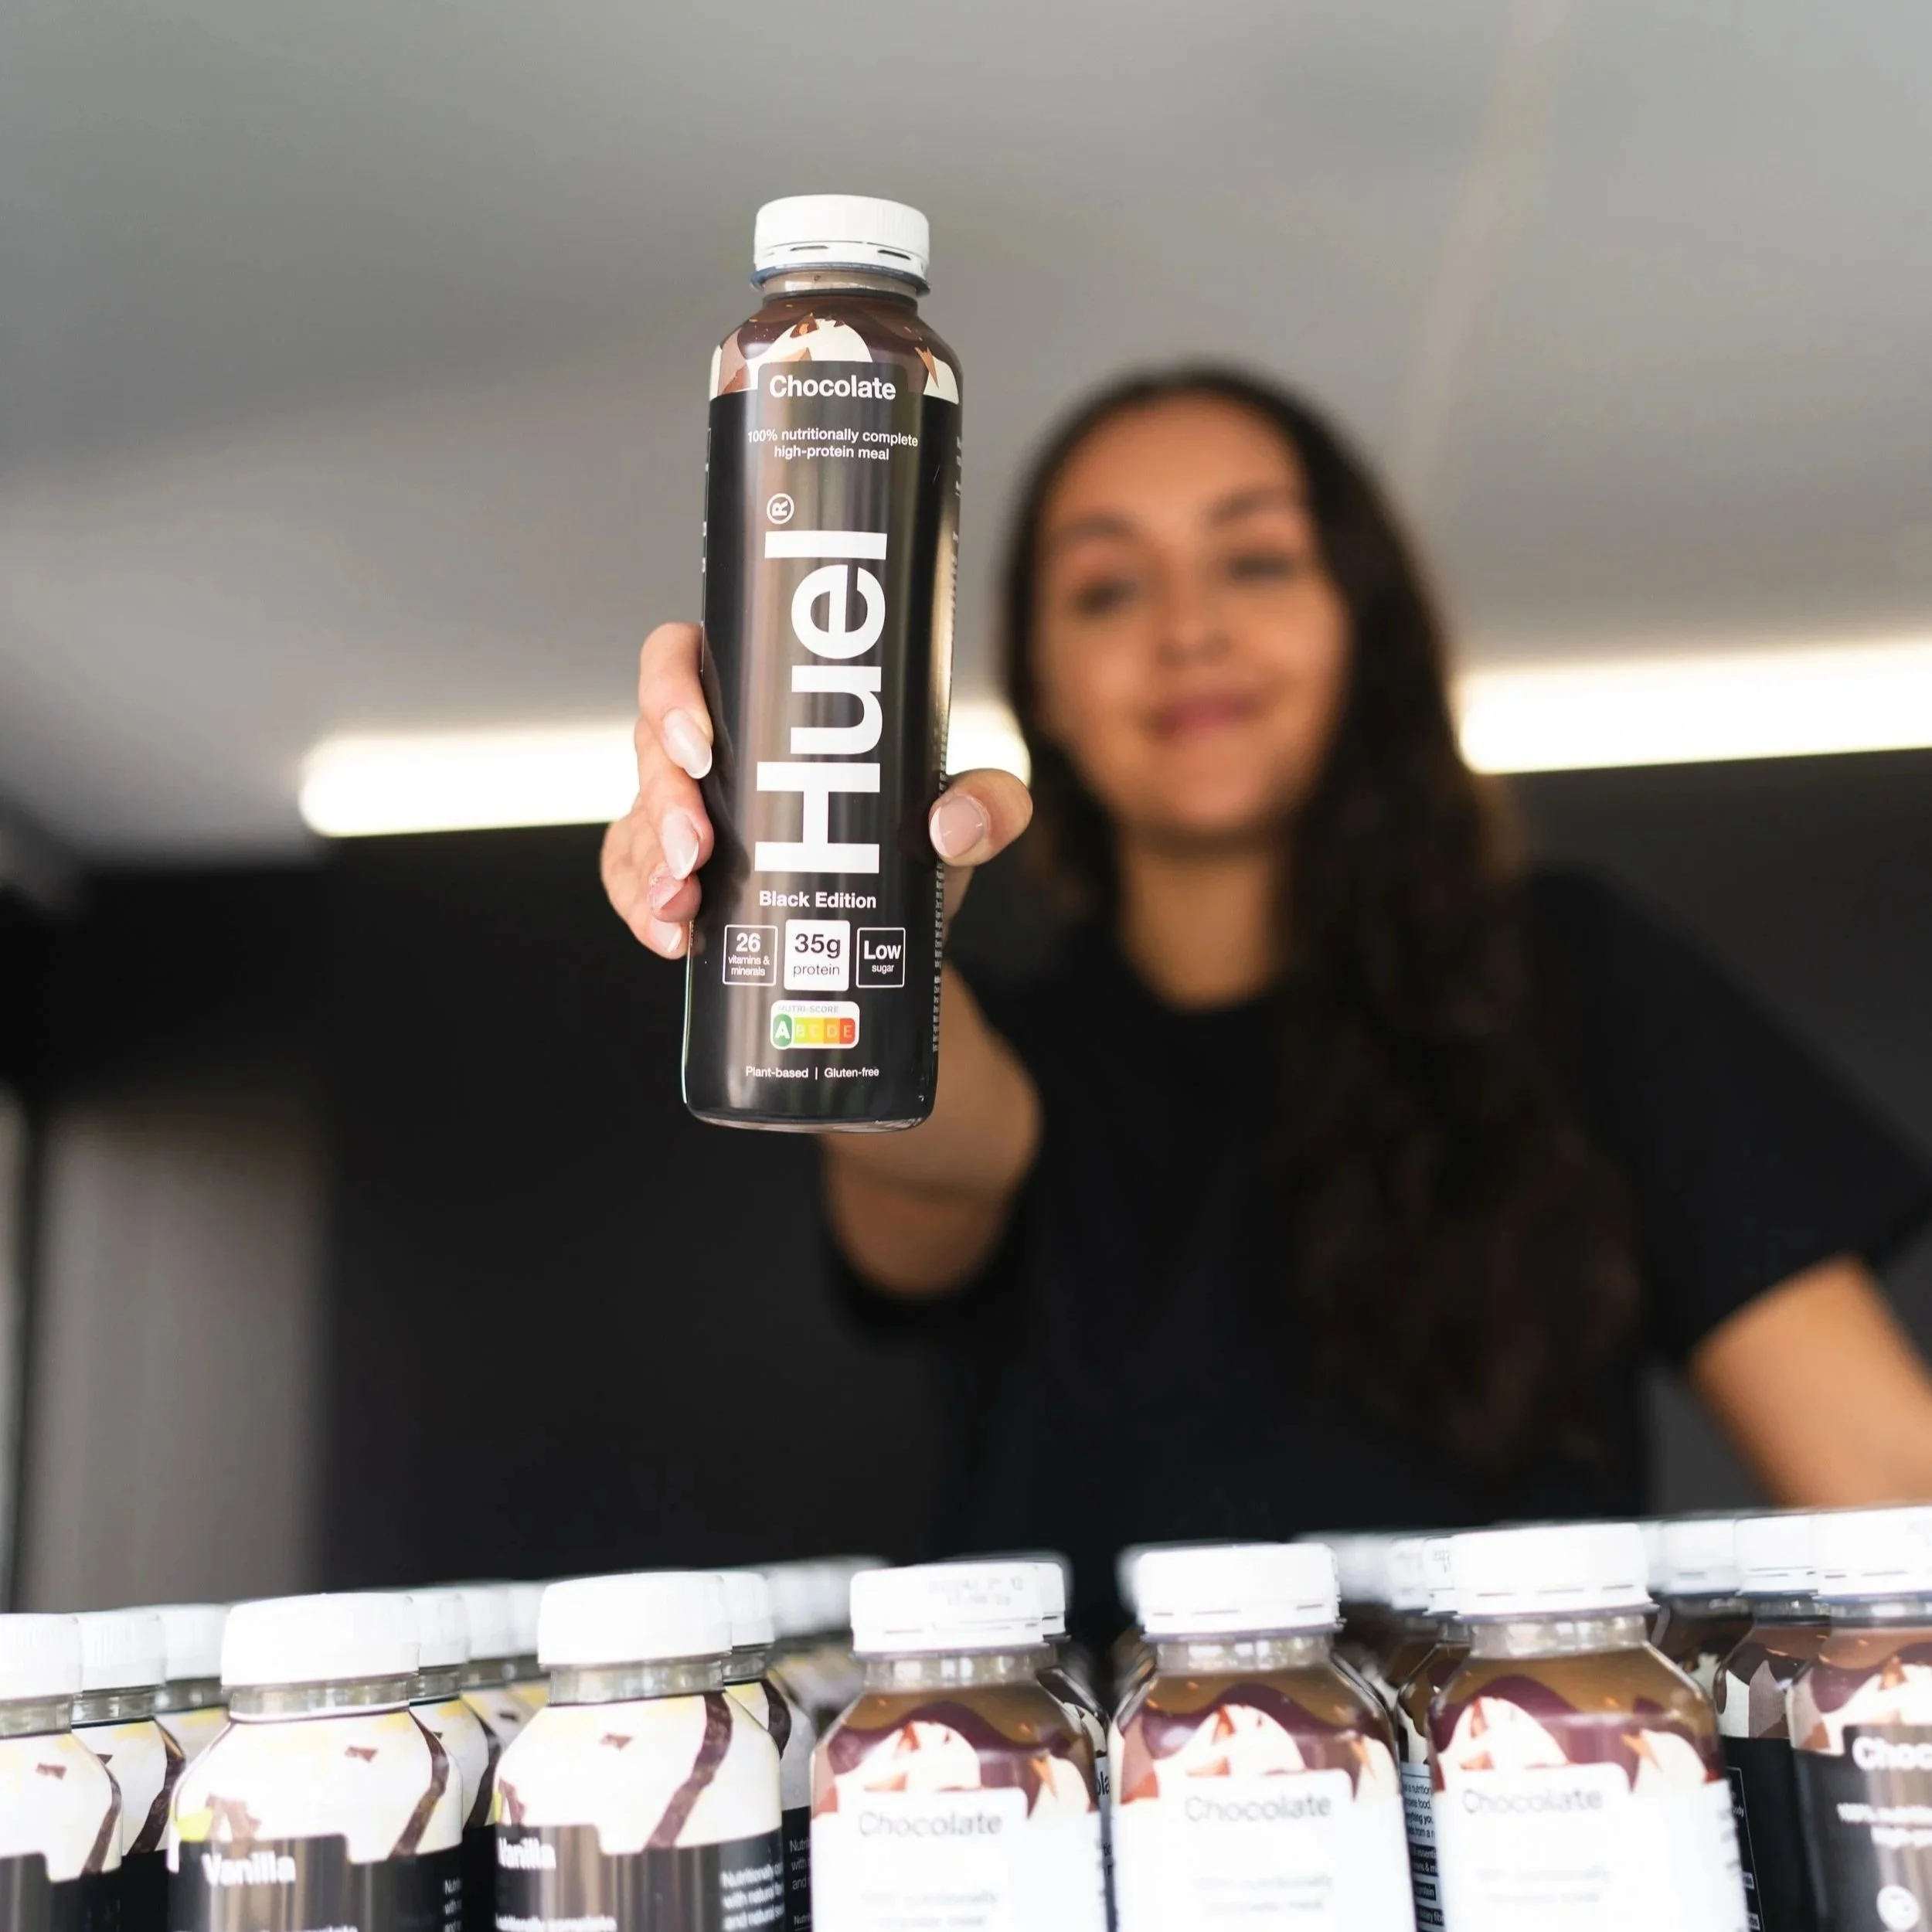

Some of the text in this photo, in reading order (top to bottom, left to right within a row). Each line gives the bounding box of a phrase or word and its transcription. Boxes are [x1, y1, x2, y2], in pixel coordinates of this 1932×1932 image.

[769, 375, 896, 400] Chocolate
[747, 427, 918, 447] 100% nutritionally complete
[774, 445, 889, 461] high-protein meal
[759, 890, 877, 909] Black Edition
[736, 932, 761, 953] 26
[794, 933, 842, 959] 35g
[863, 940, 902, 960] Low
[728, 955, 770, 965] vitamins &
[871, 964, 895, 975] sugar
[730, 966, 766, 977] minerals
[793, 964, 840, 977] protein
[777, 1005, 839, 1014] NUTRI-SCORE
[774, 1020, 791, 1039] A
[843, 1025, 852, 1038] E
[745, 1066, 879, 1079] Plant-based Gluten-free
[1185, 1794, 1332, 1821] Chocolate
[1461, 1787, 1604, 1815] Chocolate
[859, 1809, 1002, 1838] Chocolate
[201, 1850, 297, 1886] Vanilla
